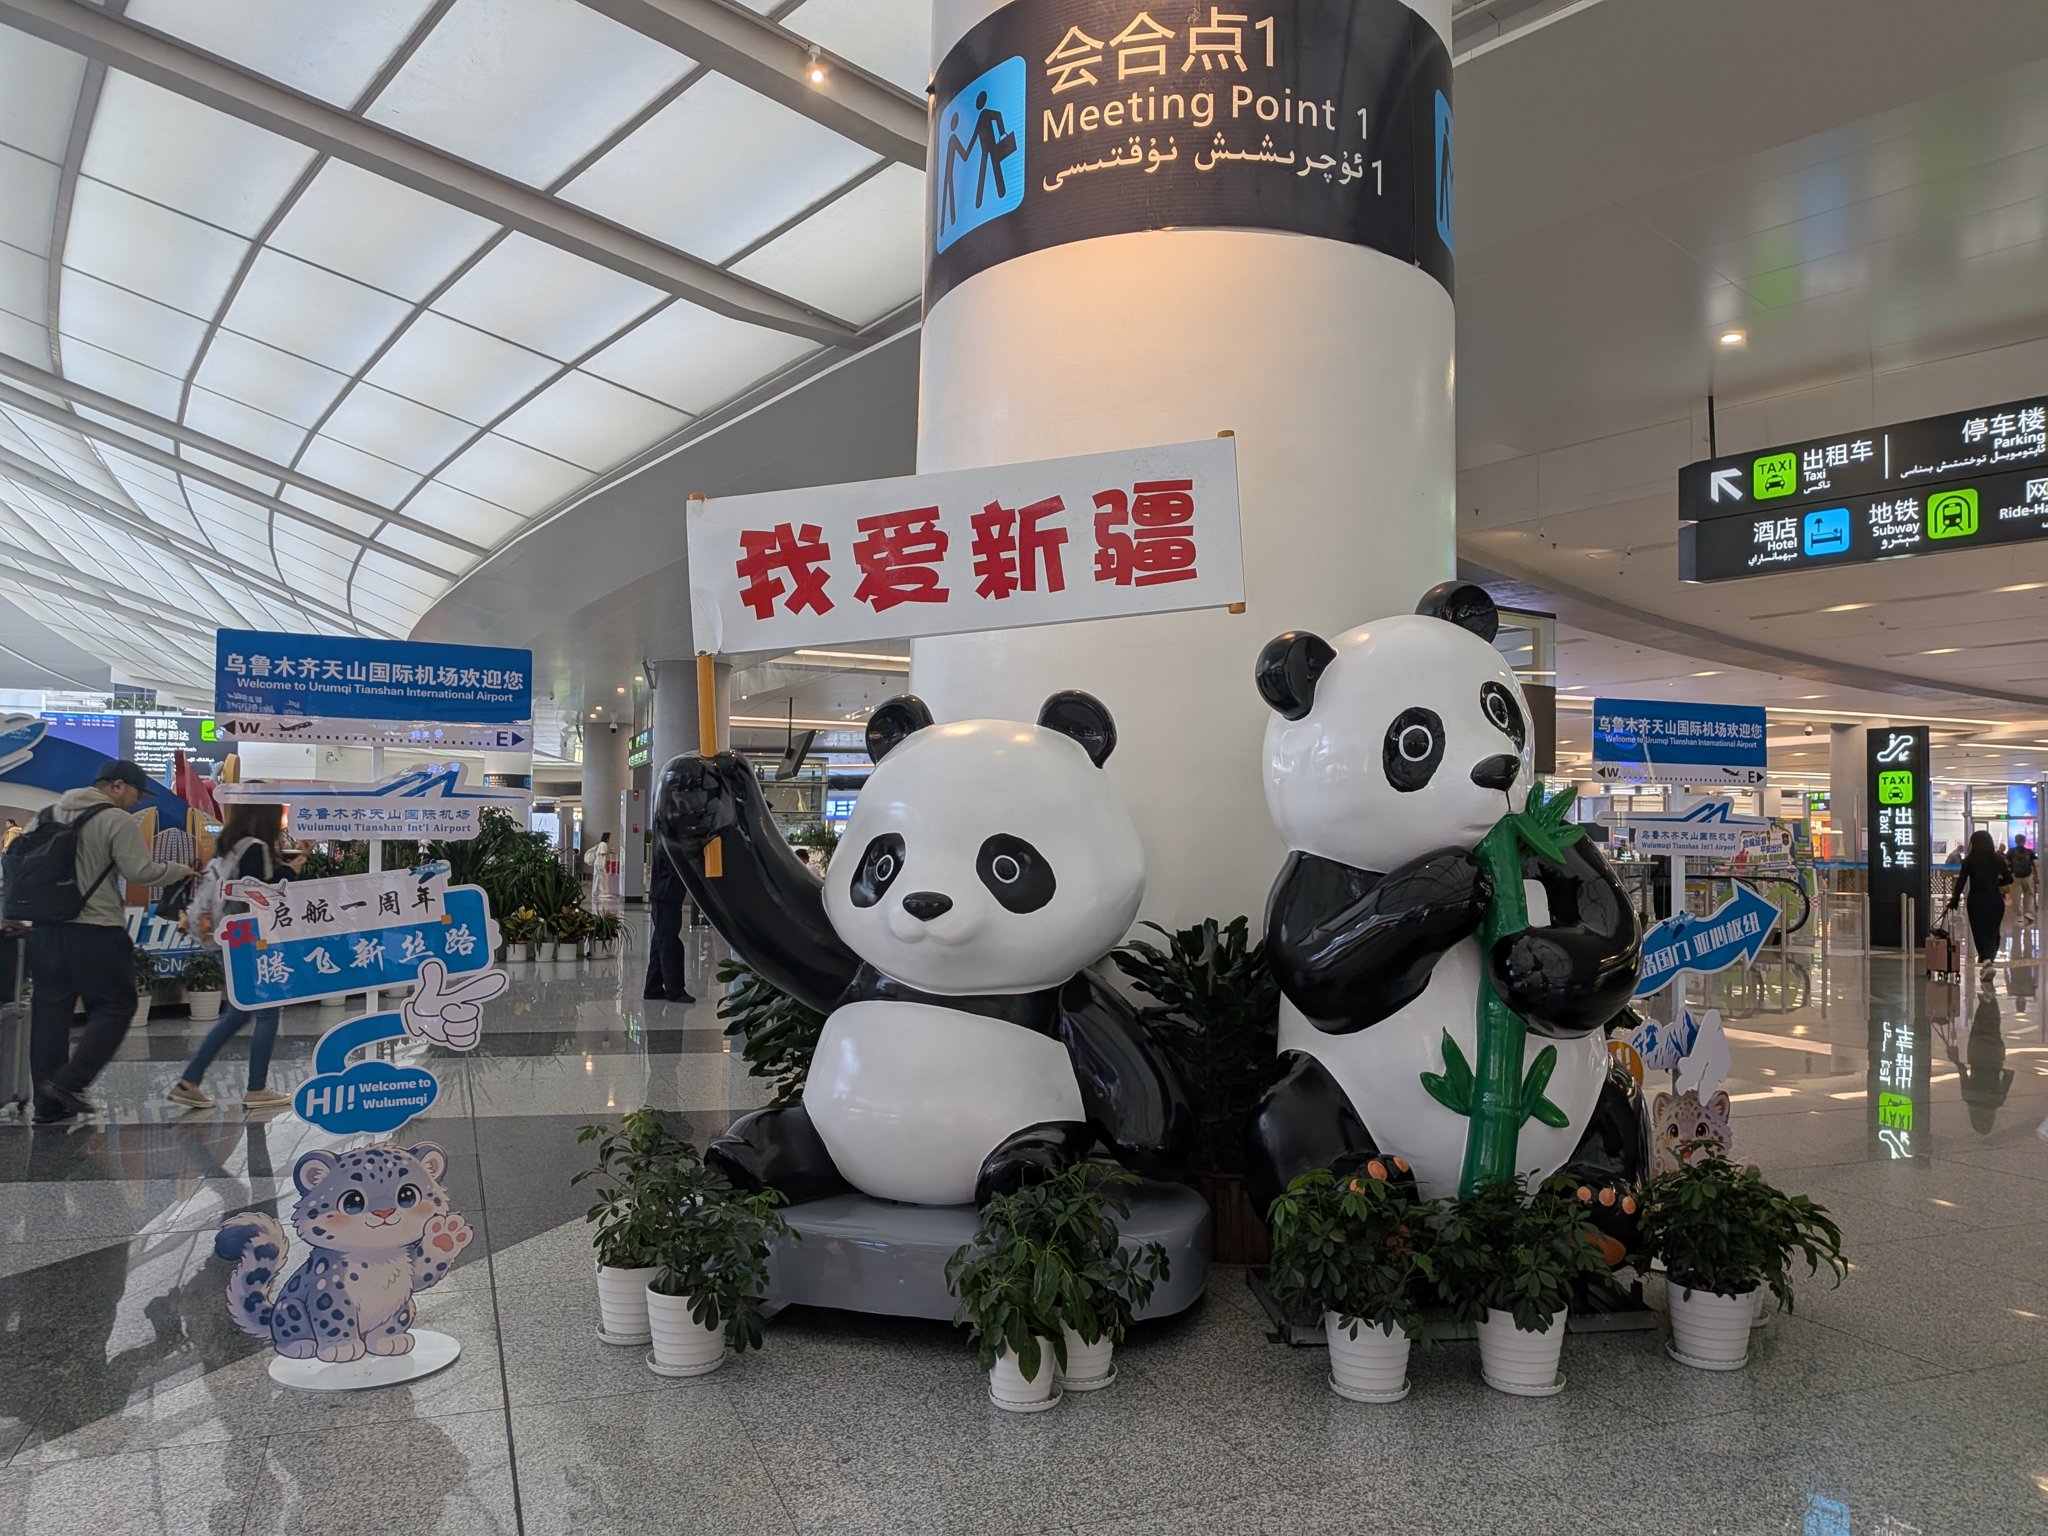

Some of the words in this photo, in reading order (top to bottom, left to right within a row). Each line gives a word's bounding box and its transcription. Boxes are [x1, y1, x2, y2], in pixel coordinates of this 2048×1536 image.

[1045, 6, 1276, 95] 会合点1
[1043, 86, 1215, 142] Meeting
[1232, 85, 1336, 131] Point
[1356, 108, 1368, 140] 1
[1371, 159, 1383, 196] 1
[1962, 407, 2046, 443] 停车楼
[1994, 432, 2046, 449] Parking
[1803, 440, 1873, 472] 出租车
[1758, 459, 1792, 475] TAXI
[1804, 468, 1827, 482] Taxi
[1869, 498, 1919, 524] 地铁
[1753, 517, 1798, 543] 酒店
[1872, 521, 1920, 537] Subway
[735, 479, 1198, 620] 我爱新疆
[1768, 538, 1797, 551] Hotel
[224, 653, 523, 691] 乌鲁木齐天山国际机场欢迎您
[237, 677, 291, 690] Welcome
[294, 681, 306, 691] to
[309, 681, 351, 694] Urumqi
[354, 684, 403, 696] Tianshan
[407, 687, 474, 700] International
[476, 691, 513, 703] Airport
[135, 718, 178, 729] 国际到达
[239, 722, 261, 734] W
[1598, 715, 1762, 739] 乌鲁木齐天山国际机场欢迎您
[135, 729, 189, 741] 港澳台到达
[496, 731, 508, 747] E
[1605, 733, 1636, 744] Welcome
[1637, 735, 1645, 744] to
[1645, 736, 1668, 745] Urumqi
[1670, 737, 1698, 746] Tianshan
[1698, 738, 1736, 748] International
[1737, 740, 1757, 749] Airport
[1606, 768, 1619, 777] W
[1748, 771, 1755, 783] E
[1881, 776, 1910, 785] TAXI
[297, 807, 471, 820] 乌鲁木齐天山国际机场
[1879, 807, 1892, 834] Taxi
[297, 823, 351, 833] Wulumuqi
[354, 823, 402, 832] Tianshan
[433, 823, 471, 833] Airport
[1641, 830, 1736, 841] 乌鲁木齐天山国际机场
[1894, 806, 1914, 868] 出租车
[1715, 843, 1736, 851] Airport
[270, 886, 436, 930] 启航一周年
[255, 924, 477, 985] 腾飞新丝路
[359, 1081, 416, 1093] Welcome
[418, 1079, 431, 1088] to
[306, 1084, 355, 1117] HI!
[363, 1093, 428, 1109] Wulumuqi
